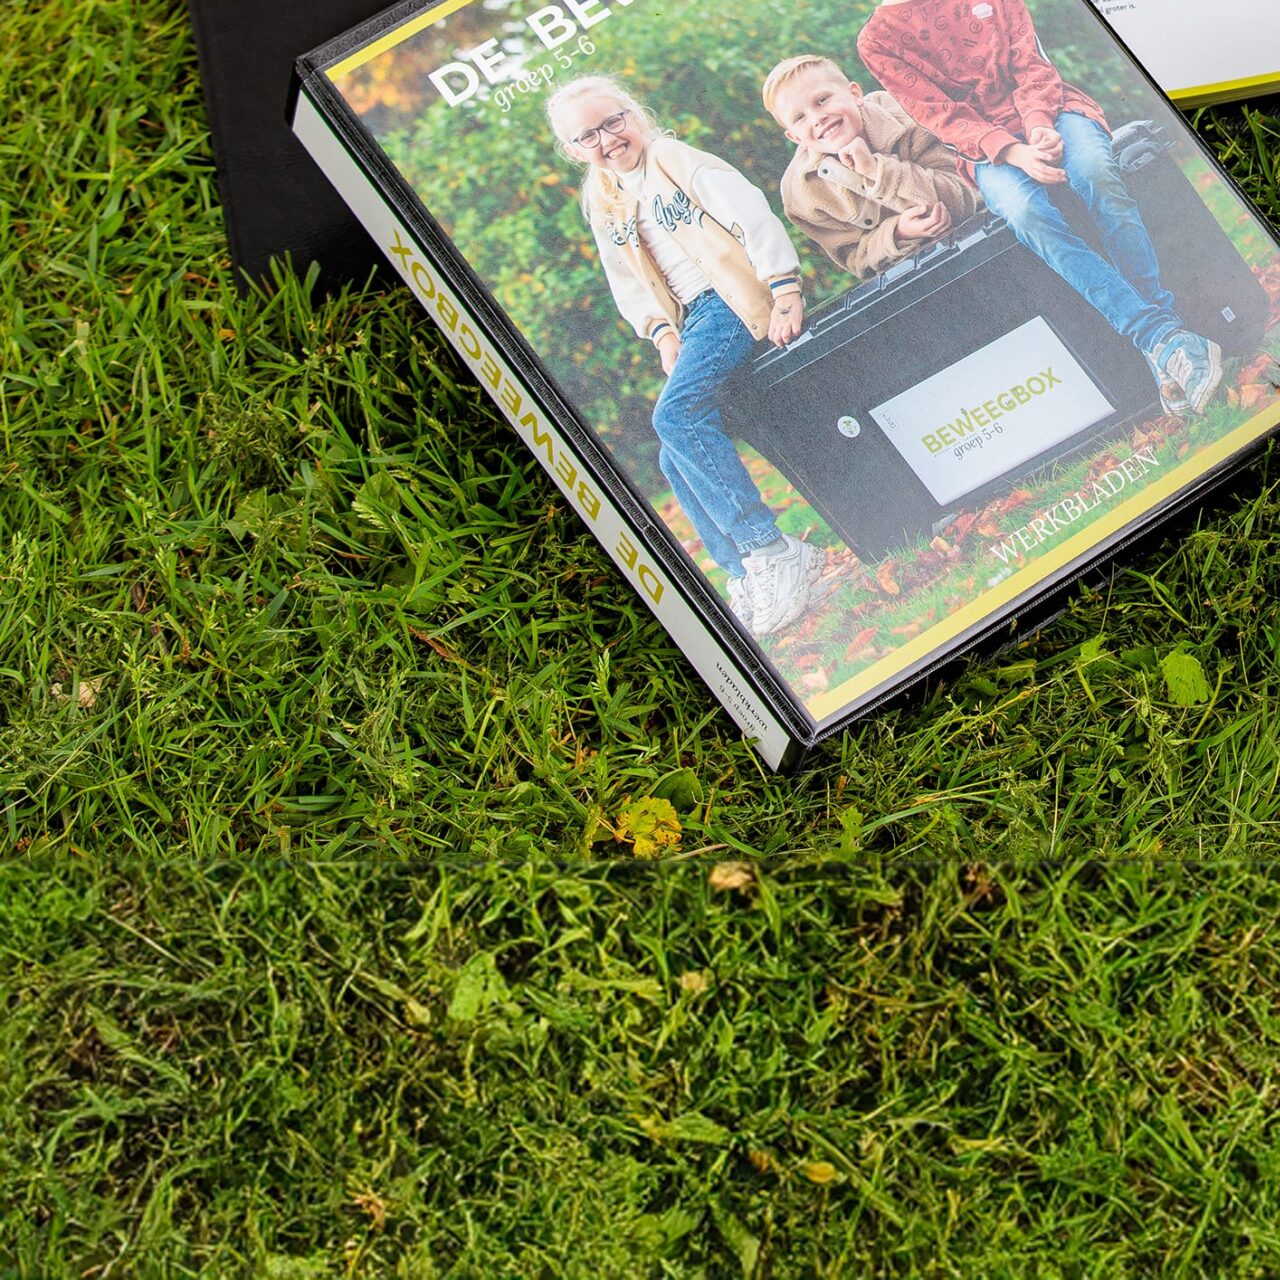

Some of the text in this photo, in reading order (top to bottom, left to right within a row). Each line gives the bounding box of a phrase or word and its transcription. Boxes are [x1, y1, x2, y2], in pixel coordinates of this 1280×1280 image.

[428, 37, 508, 108] DE
[493, 35, 596, 113] groep 5-6
[390, 228, 601, 521] BEWEEGBOX
[922, 367, 1061, 454] BEWEEGBOX
[953, 435, 984, 460] groep
[983, 422, 1004, 441] 5-6
[989, 446, 1160, 566] WERKBLADEN
[616, 531, 665, 605] DE
[716, 662, 768, 731] werkbladen
